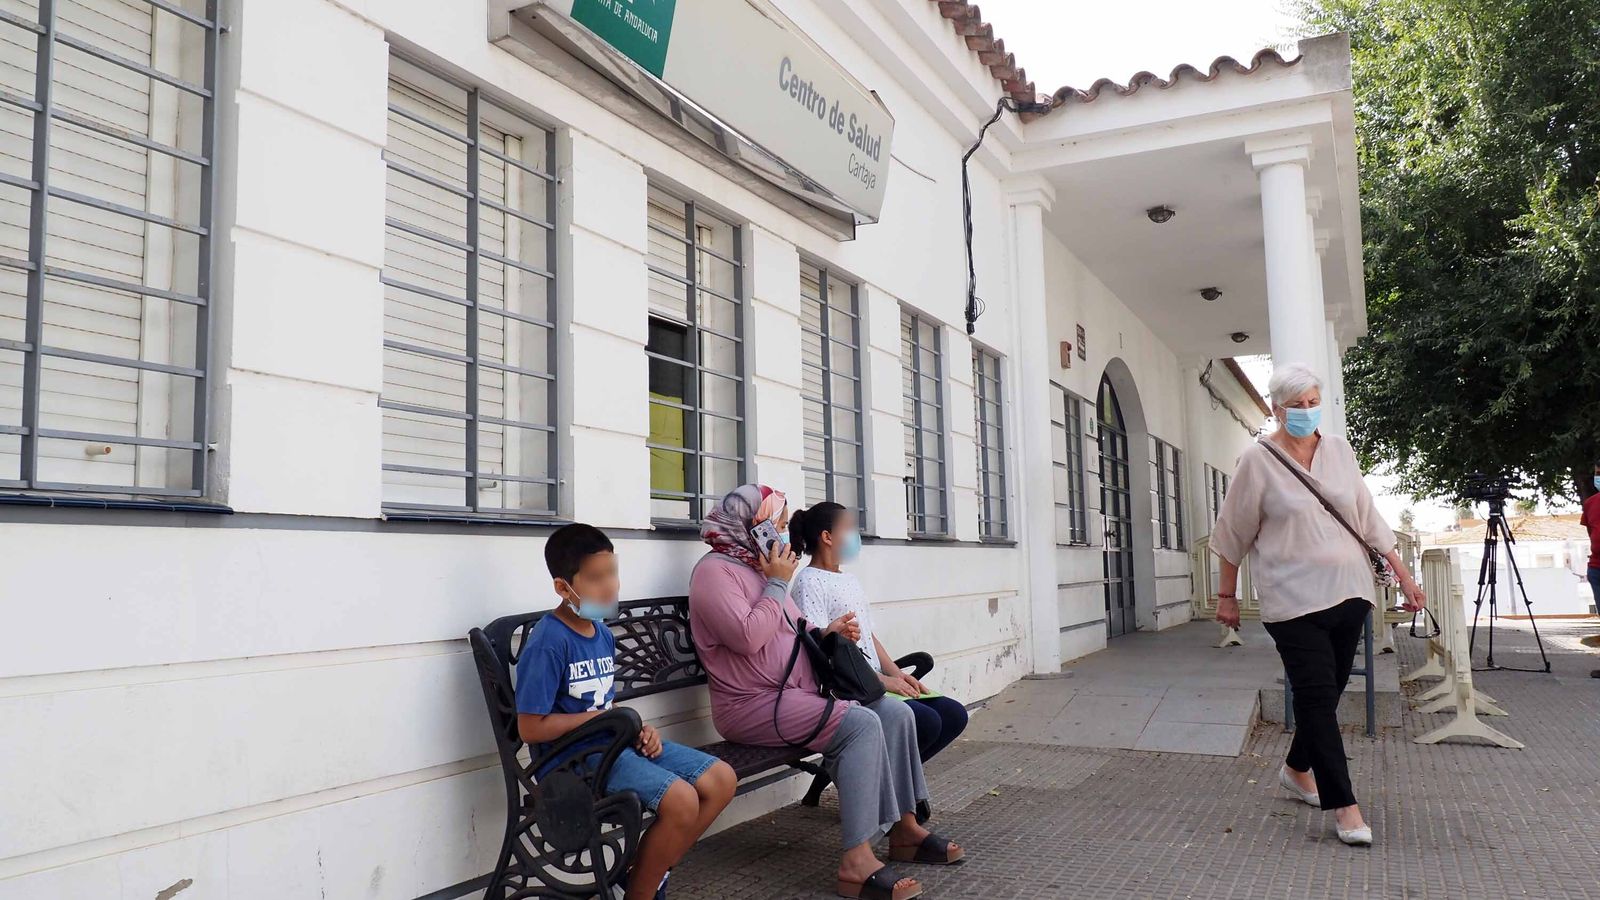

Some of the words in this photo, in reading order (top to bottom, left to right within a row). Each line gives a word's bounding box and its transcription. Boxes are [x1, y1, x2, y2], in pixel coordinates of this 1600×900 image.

[613, 1, 623, 18] DE
[624, 9, 658, 44] ANDALUCIA
[779, 56, 826, 120] Centro
[828, 99, 845, 135] de
[847, 113, 882, 162] Salud
[848, 153, 876, 190] Cartaya
[569, 659, 596, 680] NEW
[597, 655, 615, 675] YOR
